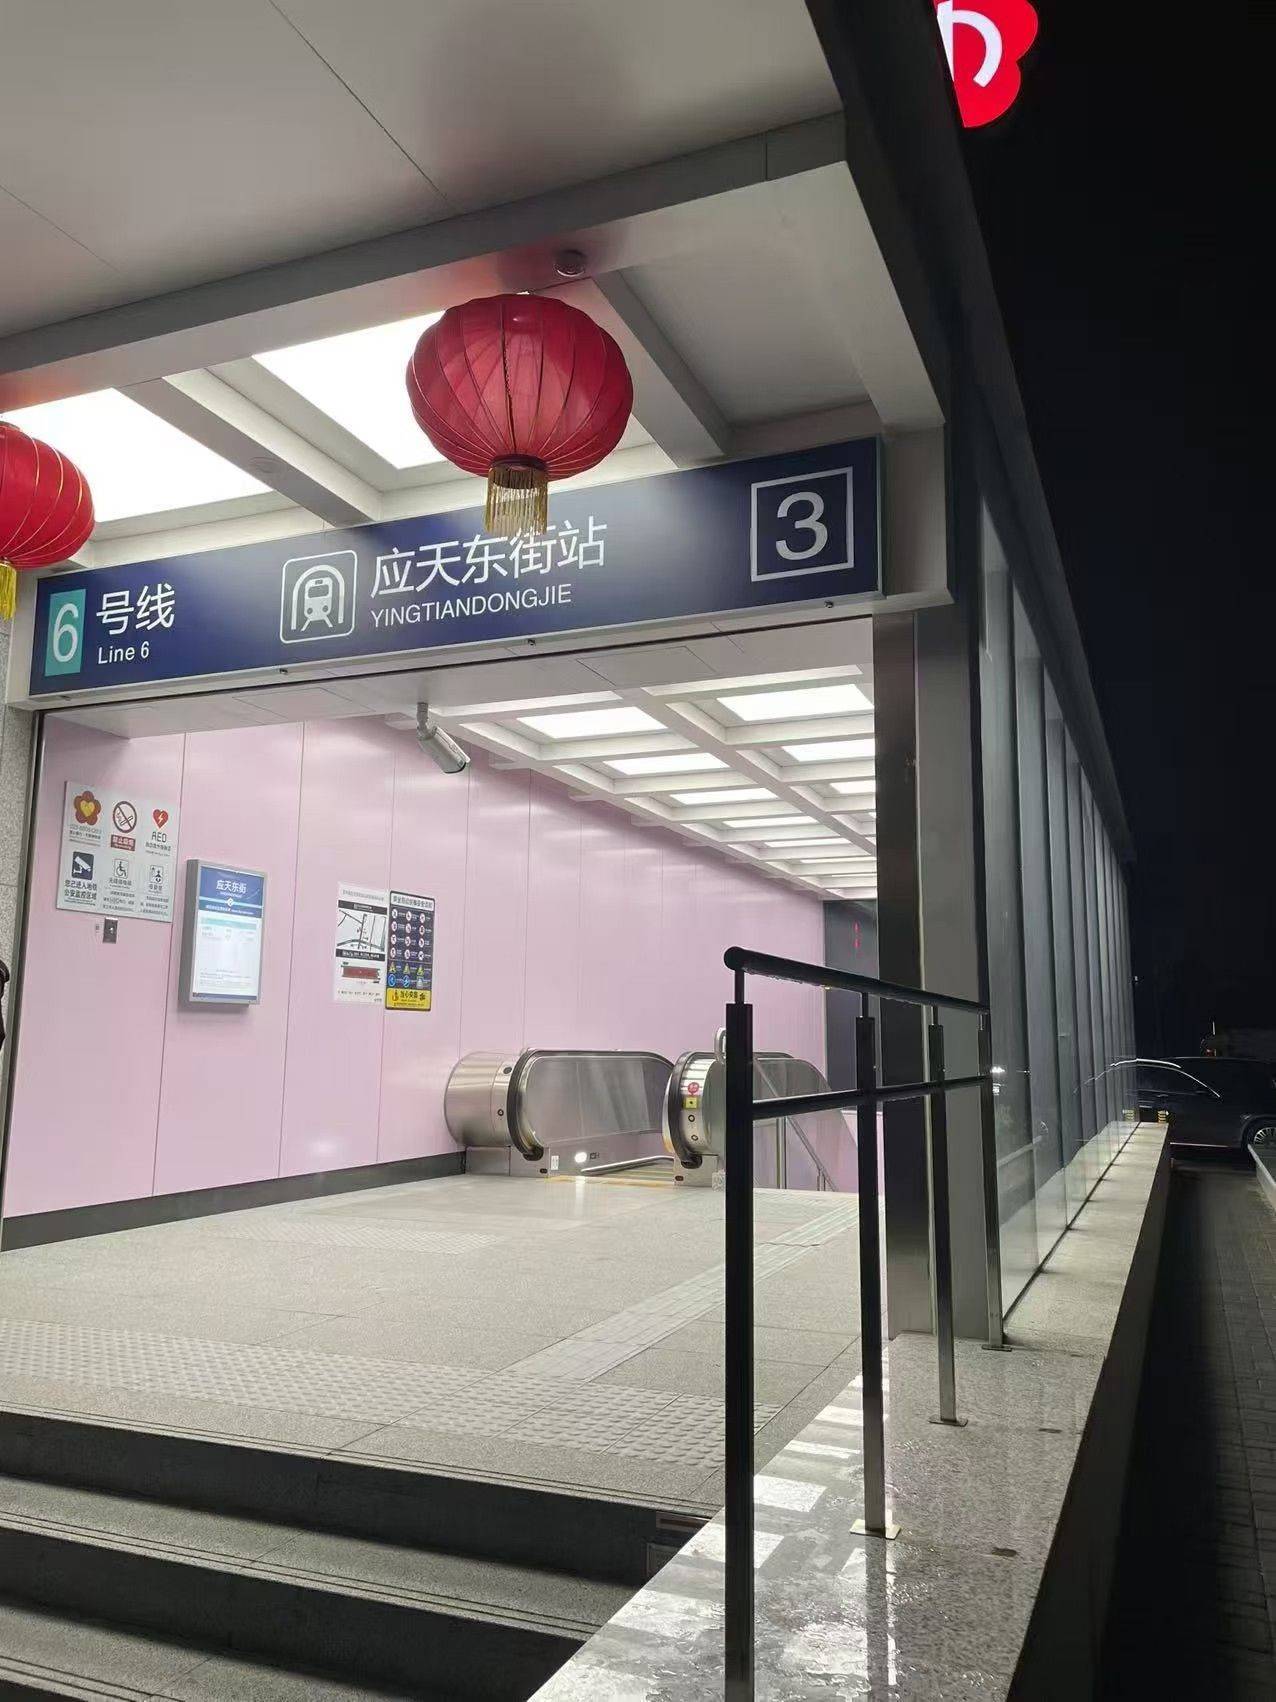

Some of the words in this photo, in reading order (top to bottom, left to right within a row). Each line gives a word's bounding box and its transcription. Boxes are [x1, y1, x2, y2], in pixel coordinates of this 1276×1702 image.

[775, 491, 829, 561] 3
[370, 516, 608, 598] 应天东街站
[52, 603, 79, 663] 6
[96, 582, 176, 636] 号线
[371, 583, 572, 628] YINGTIANDONGJIE
[97, 645, 135, 665] Line
[140, 641, 150, 659] 6
[151, 832, 168, 843] AED
[215, 879, 248, 893] 应天东街
